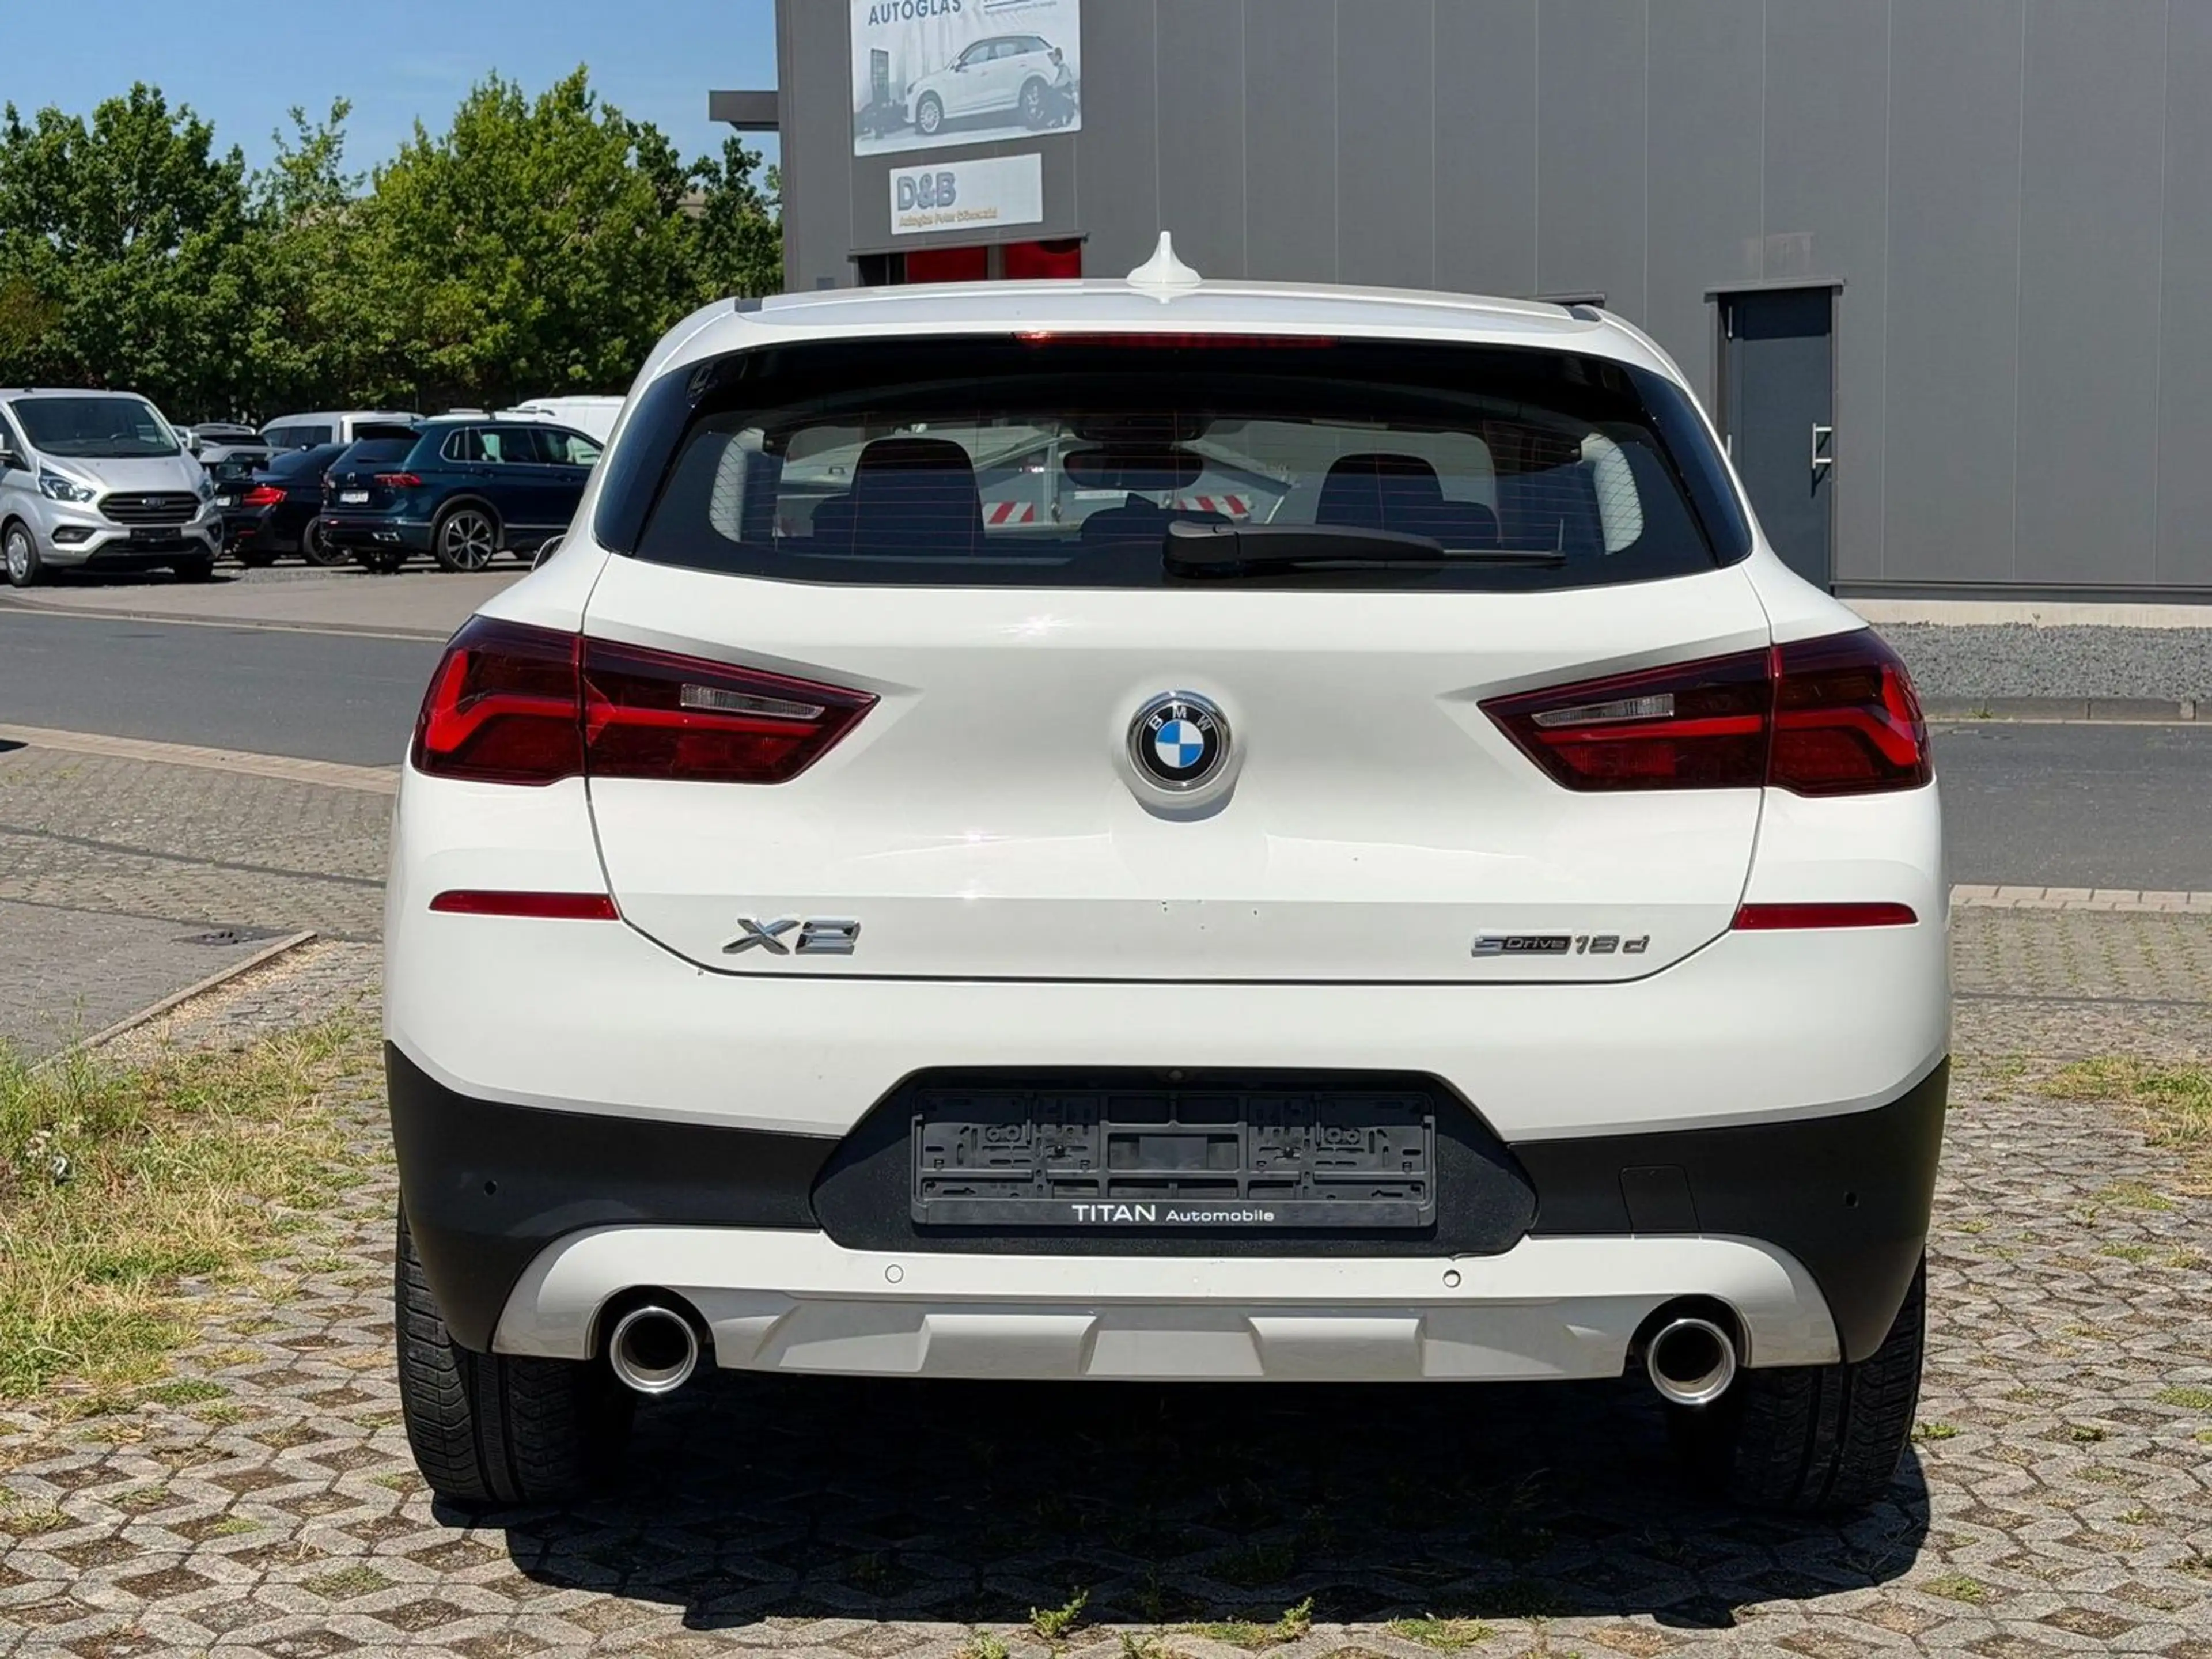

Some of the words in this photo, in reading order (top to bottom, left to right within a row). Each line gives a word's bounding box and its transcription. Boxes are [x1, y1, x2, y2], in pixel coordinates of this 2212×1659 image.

[868, 0, 961, 26] AUTOGLAS
[897, 172, 956, 211] D&B
[1149, 706, 1212, 732] BMW
[722, 918, 861, 955] X2
[1071, 1205, 1156, 1222] TITAN
[1165, 1210, 1275, 1222] Automobile
